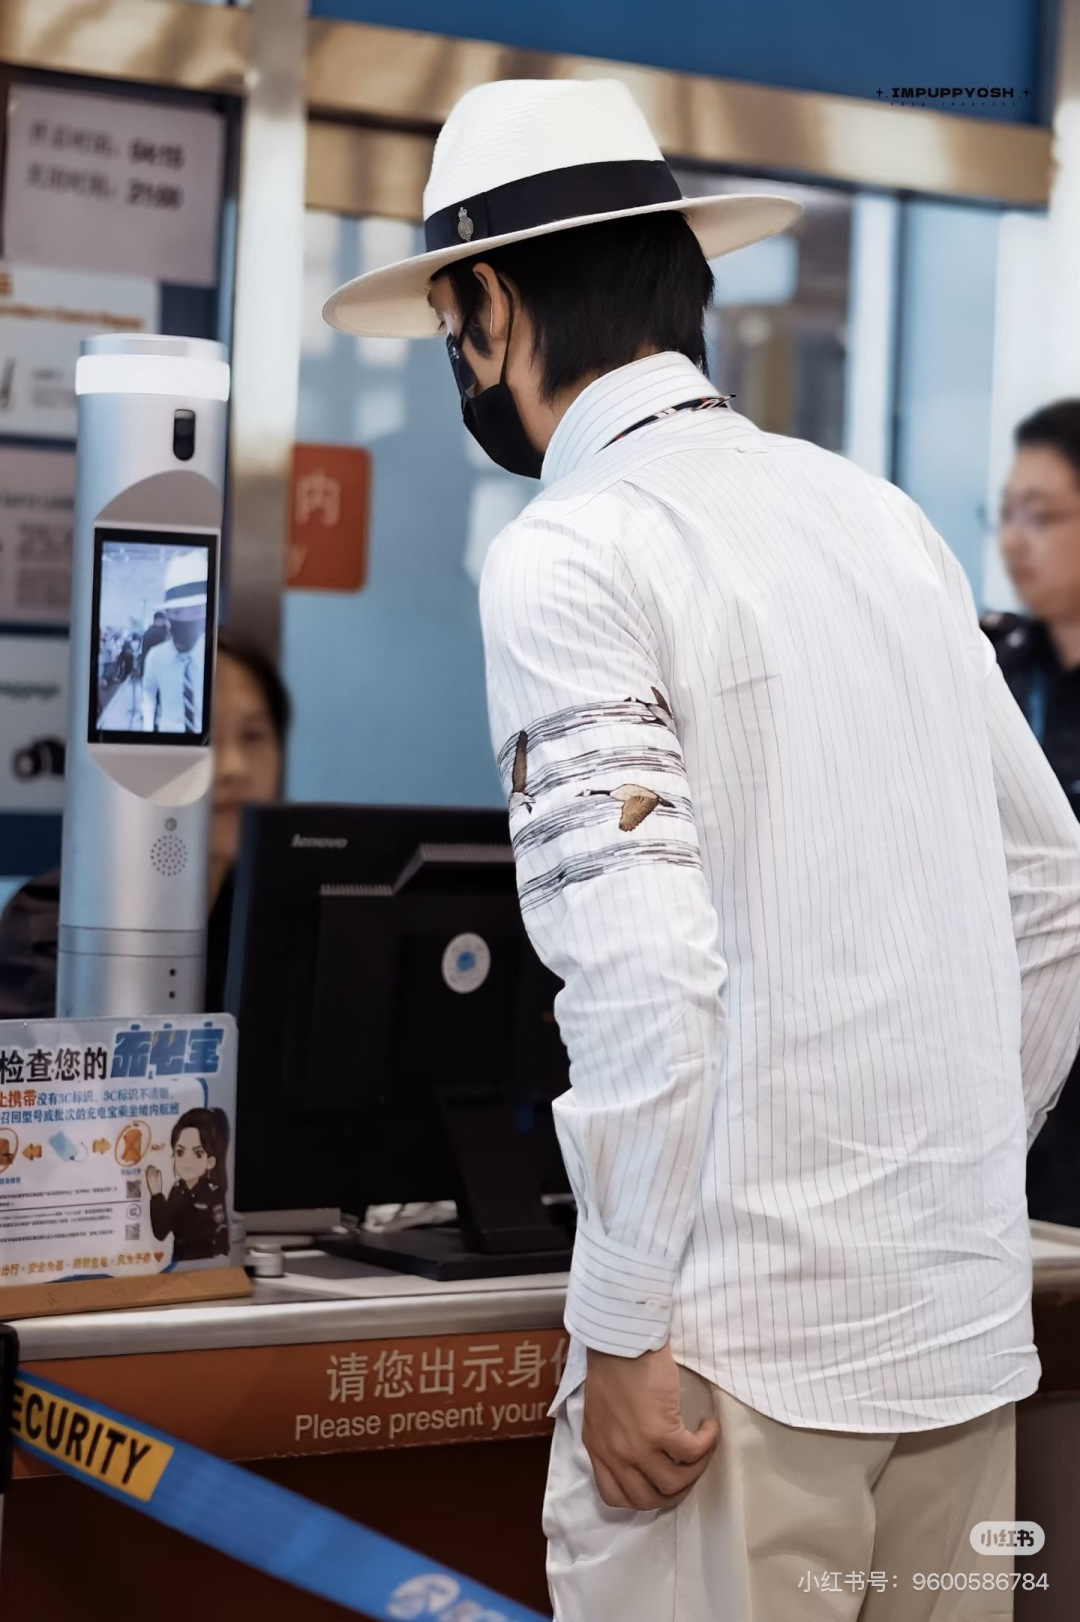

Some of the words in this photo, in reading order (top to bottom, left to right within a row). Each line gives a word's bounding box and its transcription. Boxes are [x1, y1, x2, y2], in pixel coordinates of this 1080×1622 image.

[292, 833, 348, 849] lenovo
[295, 1414, 381, 1440] Please
[389, 1403, 483, 1438] present
[492, 1402, 547, 1431] your
